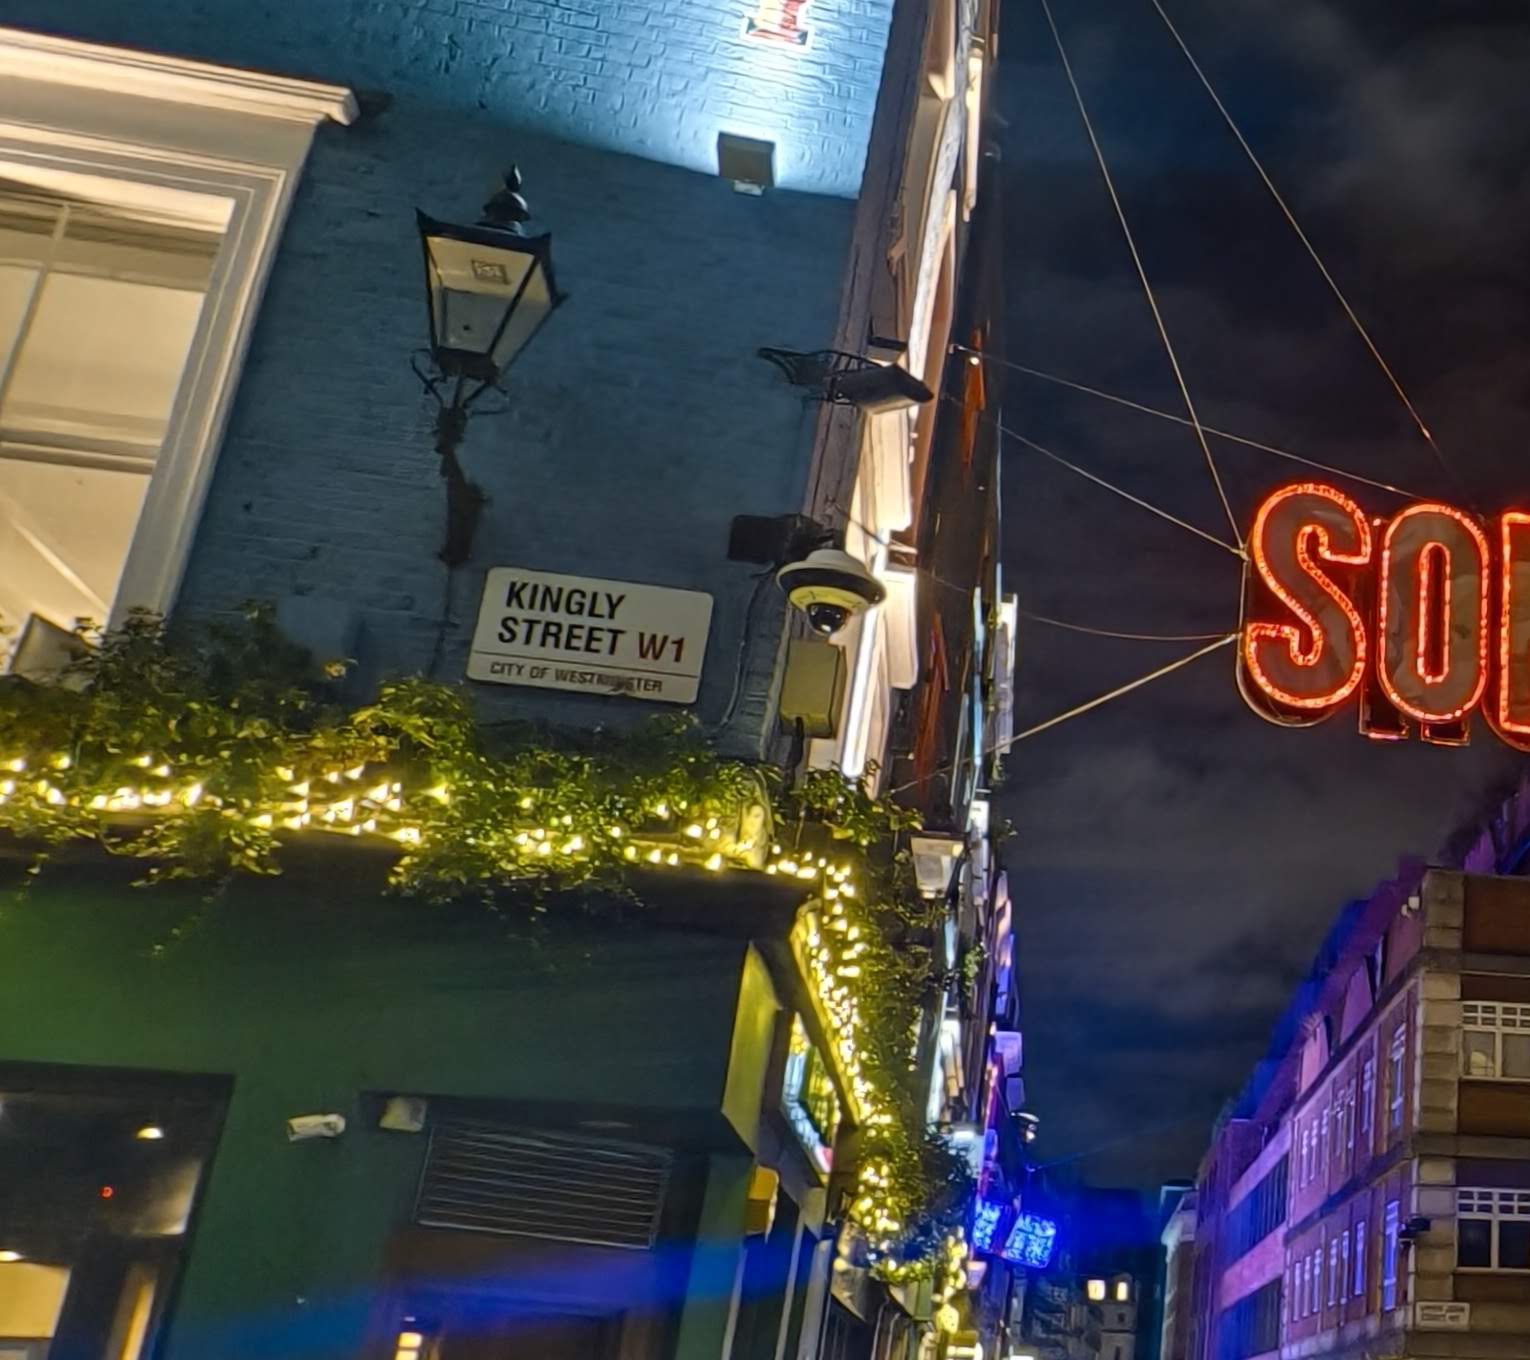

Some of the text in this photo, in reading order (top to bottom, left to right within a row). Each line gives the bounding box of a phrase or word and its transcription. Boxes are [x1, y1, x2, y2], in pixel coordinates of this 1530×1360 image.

[505, 580, 627, 620] KINGLY
[498, 616, 685, 663] STREET W1
[490, 662, 525, 676] CITY
[529, 665, 550, 679] OF
